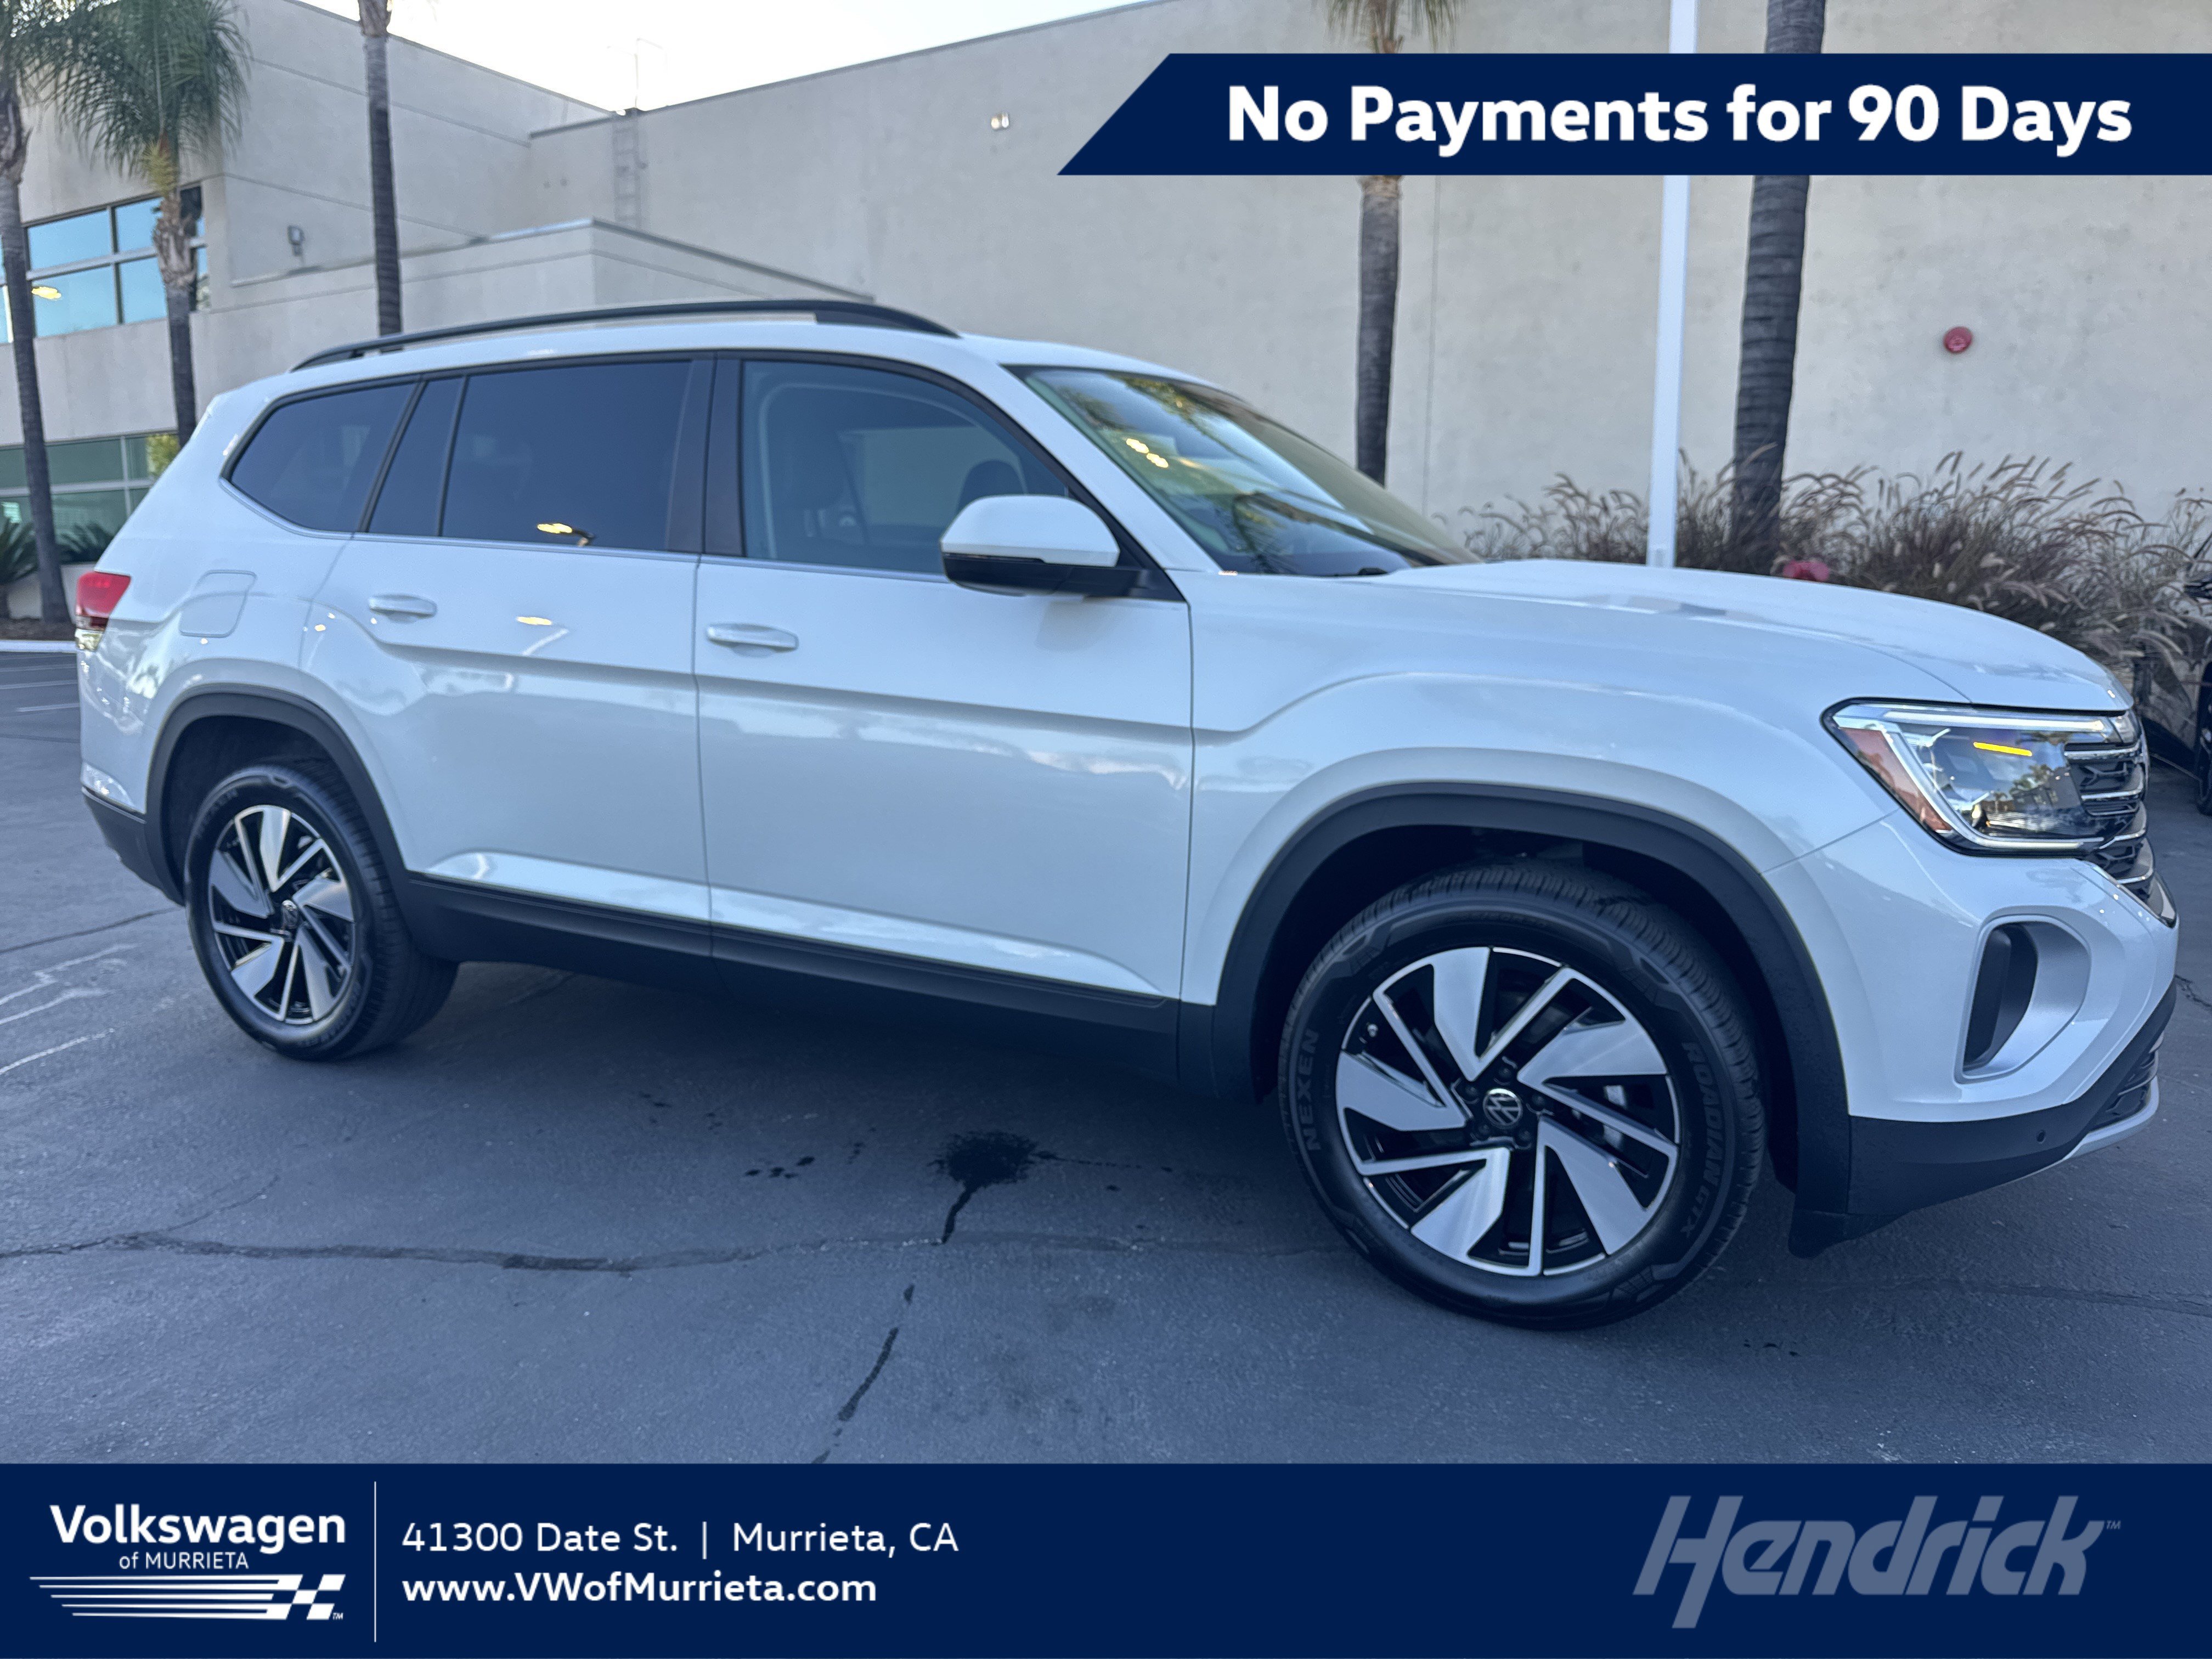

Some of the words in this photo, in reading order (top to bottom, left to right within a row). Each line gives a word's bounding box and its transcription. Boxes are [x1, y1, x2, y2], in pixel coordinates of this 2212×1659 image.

[1297, 1028, 1322, 1150] NEXEN
[1681, 1041, 1724, 1187] ROADIAN
[1680, 1184, 1711, 1238] GTX
